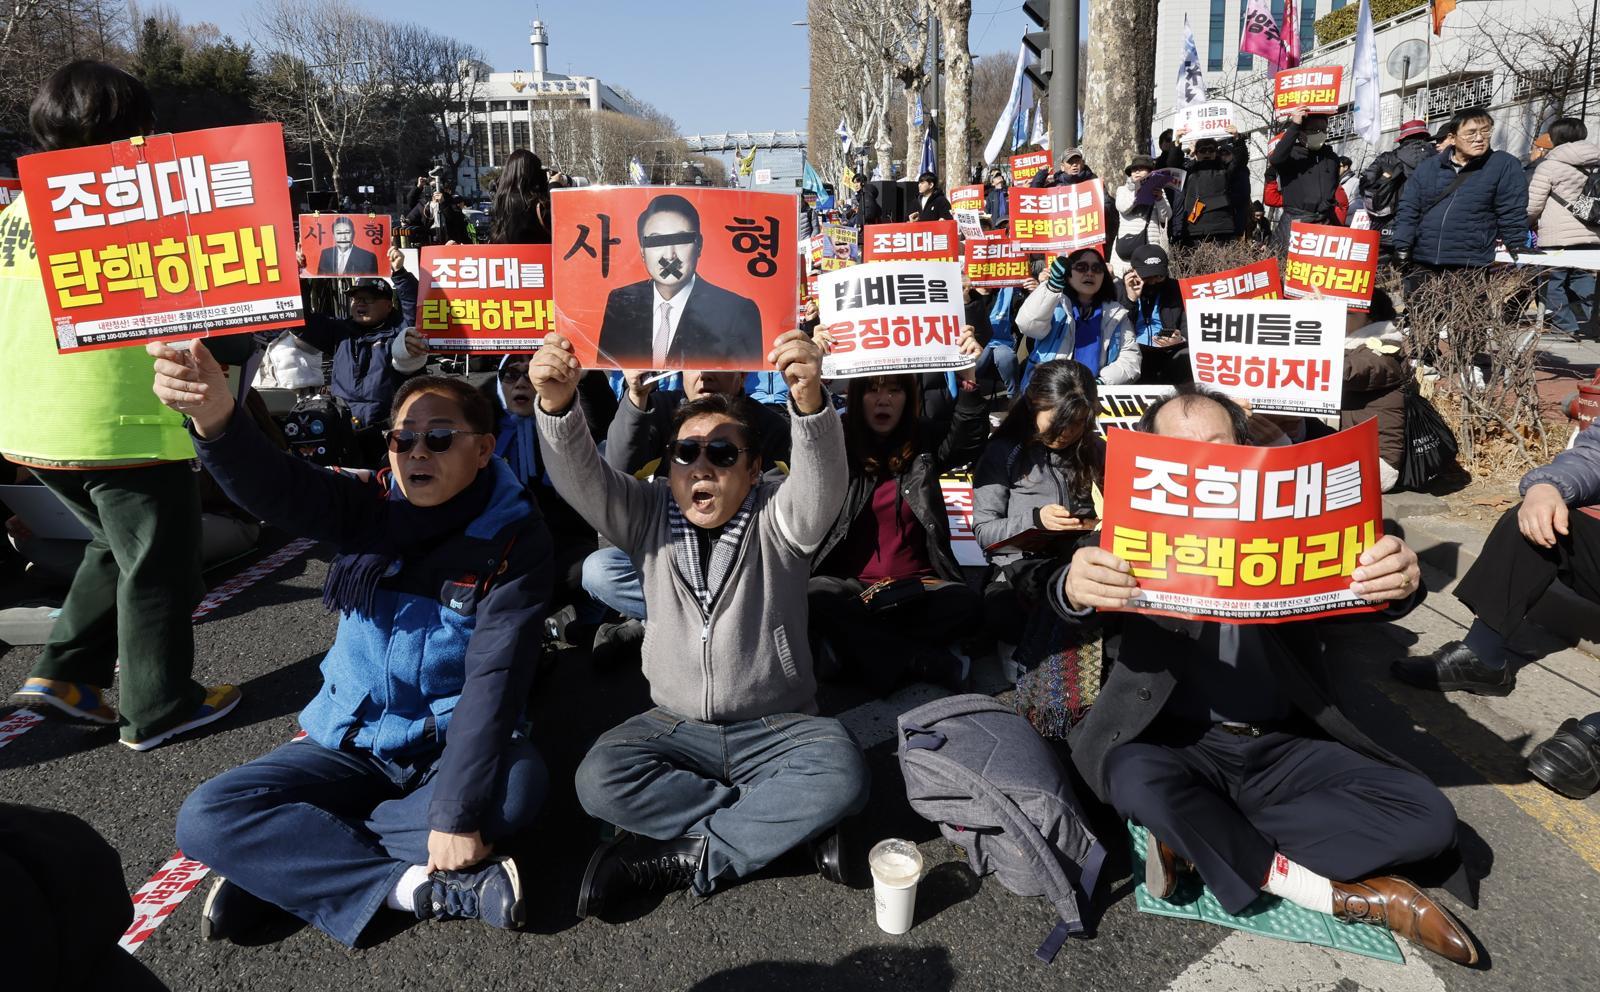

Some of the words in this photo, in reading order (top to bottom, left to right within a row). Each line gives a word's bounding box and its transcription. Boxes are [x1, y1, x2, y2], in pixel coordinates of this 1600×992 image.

[1280, 72, 1334, 90] 조희대를
[1277, 89, 1336, 108] 탄핵하라!
[1014, 155, 1047, 168] 조희대를
[48, 155, 254, 232] 조희대를
[1020, 192, 1092, 214] 조희대를
[304, 223, 326, 246] 사
[363, 223, 383, 246] 형
[1015, 212, 1099, 239] 탄핵하라!
[563, 214, 621, 278] 사
[725, 216, 780, 278] 형
[873, 232, 948, 253] 조희대를
[1288, 230, 1370, 262] 조희대를
[48, 225, 280, 308] 탄핵하라!
[431, 257, 544, 289] 조희대를
[968, 261, 1028, 278] 탄핵하라!
[835, 274, 949, 312] 법비들을
[1191, 272, 1269, 299] 조희대를
[99, 319, 129, 330] 내란청산!
[229, 304, 253, 314] 모이자!
[423, 299, 555, 330] 탄핵하라!
[1200, 312, 1323, 346] 법비들을
[826, 315, 960, 354] 응징하자!
[1195, 352, 1331, 392] 응징하자!
[1130, 455, 1362, 522] 조희대를
[1113, 520, 1376, 587] 탄핵하라!
[1156, 593, 1192, 605] 내란청산!
[1253, 598, 1311, 609] 촛불대행진으로
[1313, 593, 1340, 603] 모이자!
[141, 860, 203, 905] NGER!
